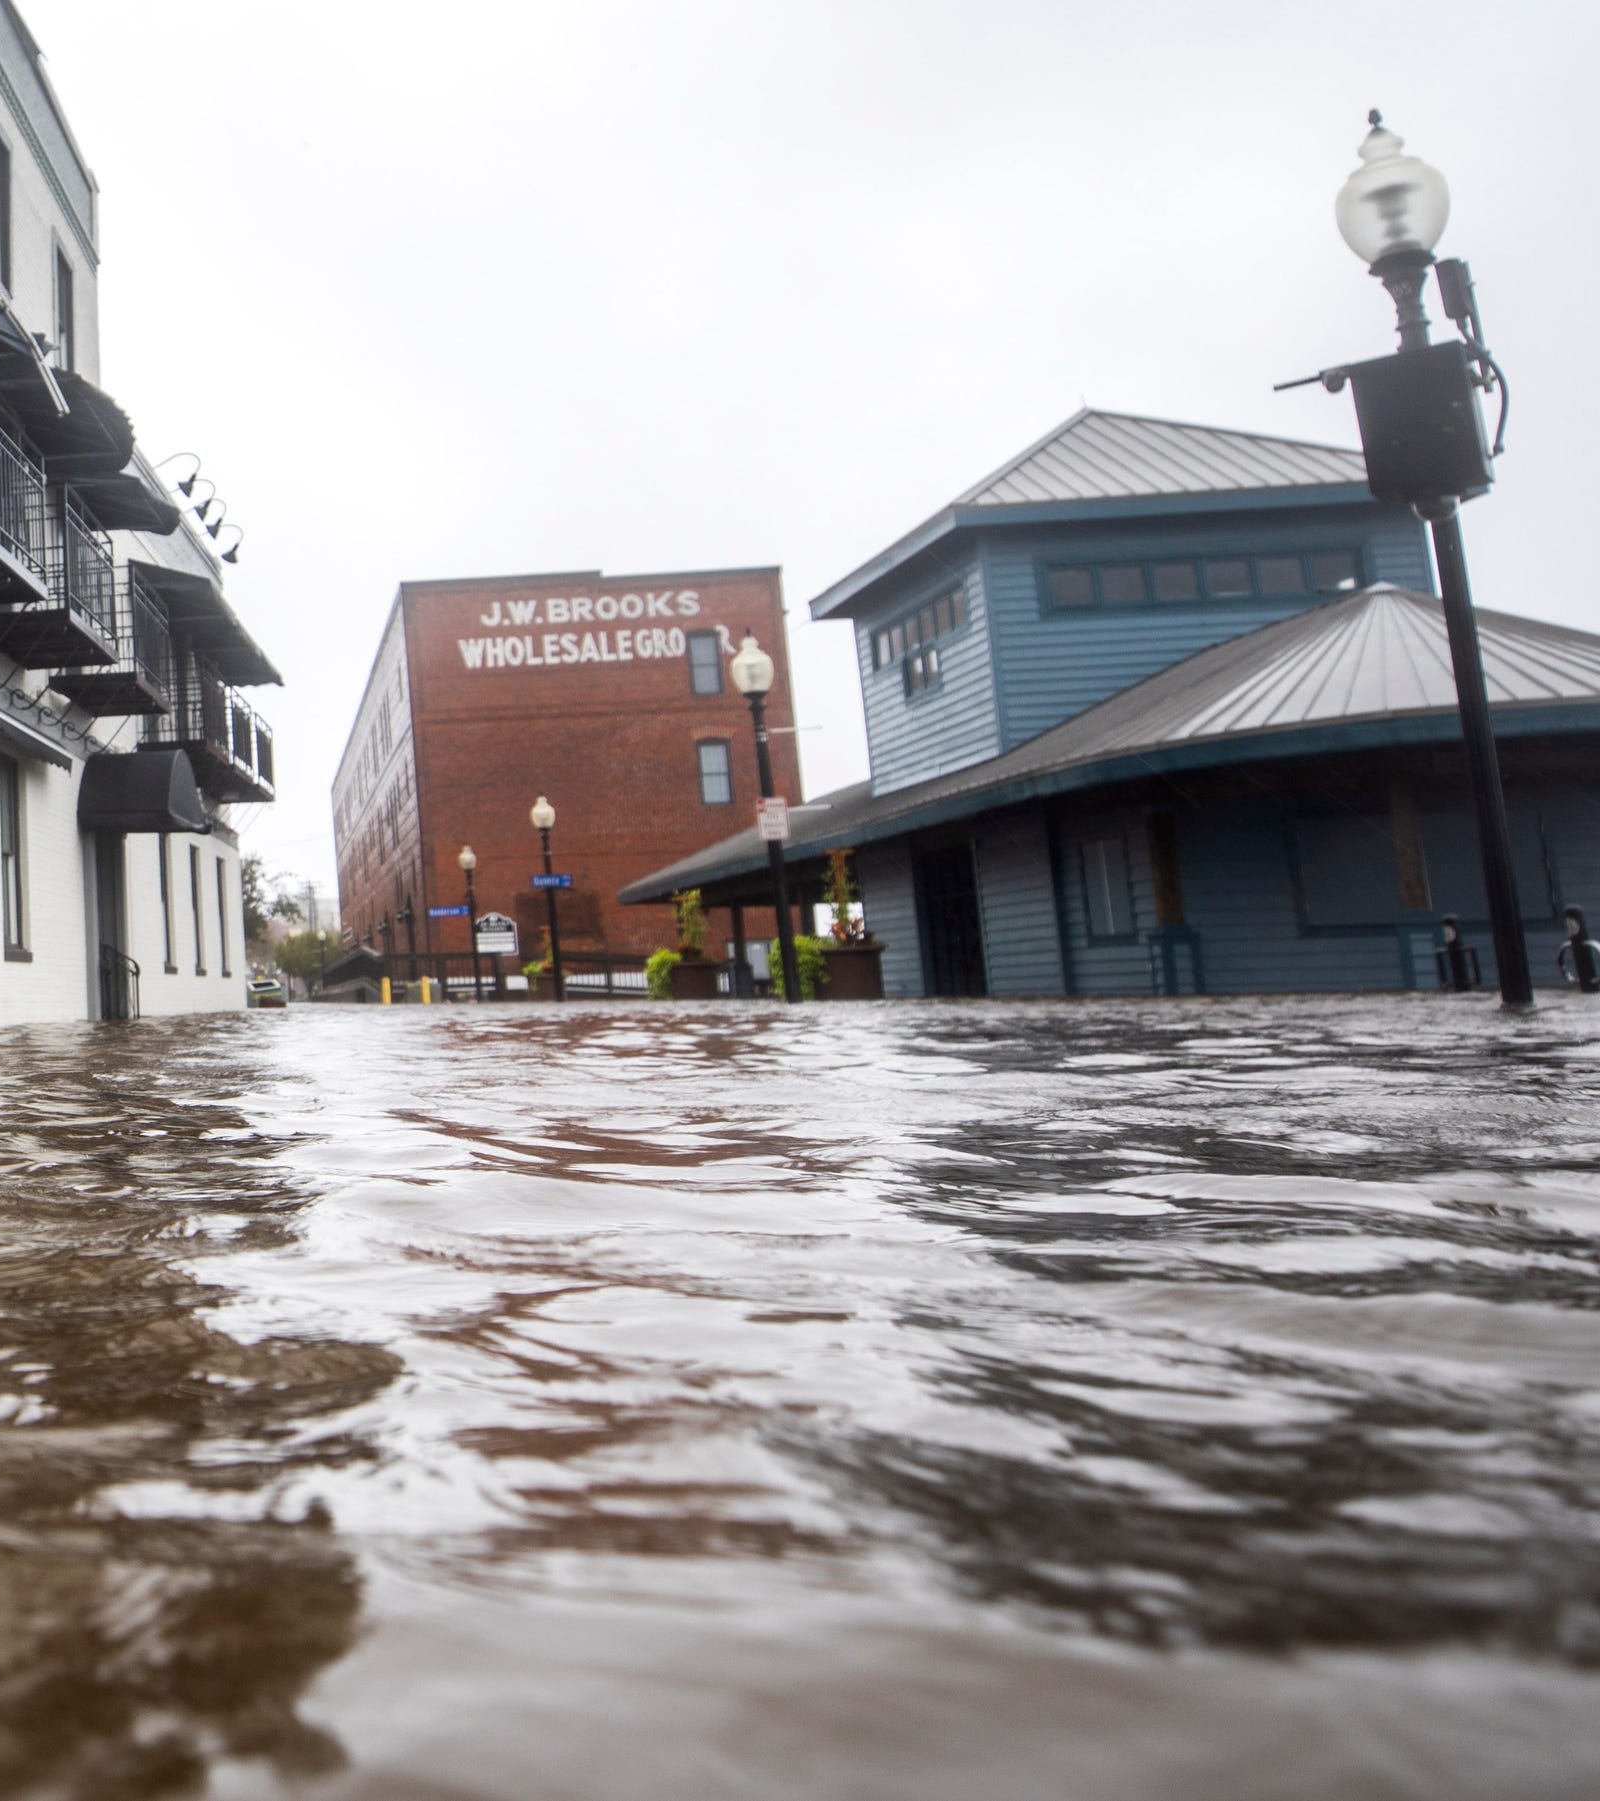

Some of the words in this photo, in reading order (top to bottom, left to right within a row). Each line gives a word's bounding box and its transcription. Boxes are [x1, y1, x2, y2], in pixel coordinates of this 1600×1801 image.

[480, 599, 544, 627] J.W.
[545, 589, 701, 625] BROOKS
[457, 630, 634, 669] WHOLESALE
